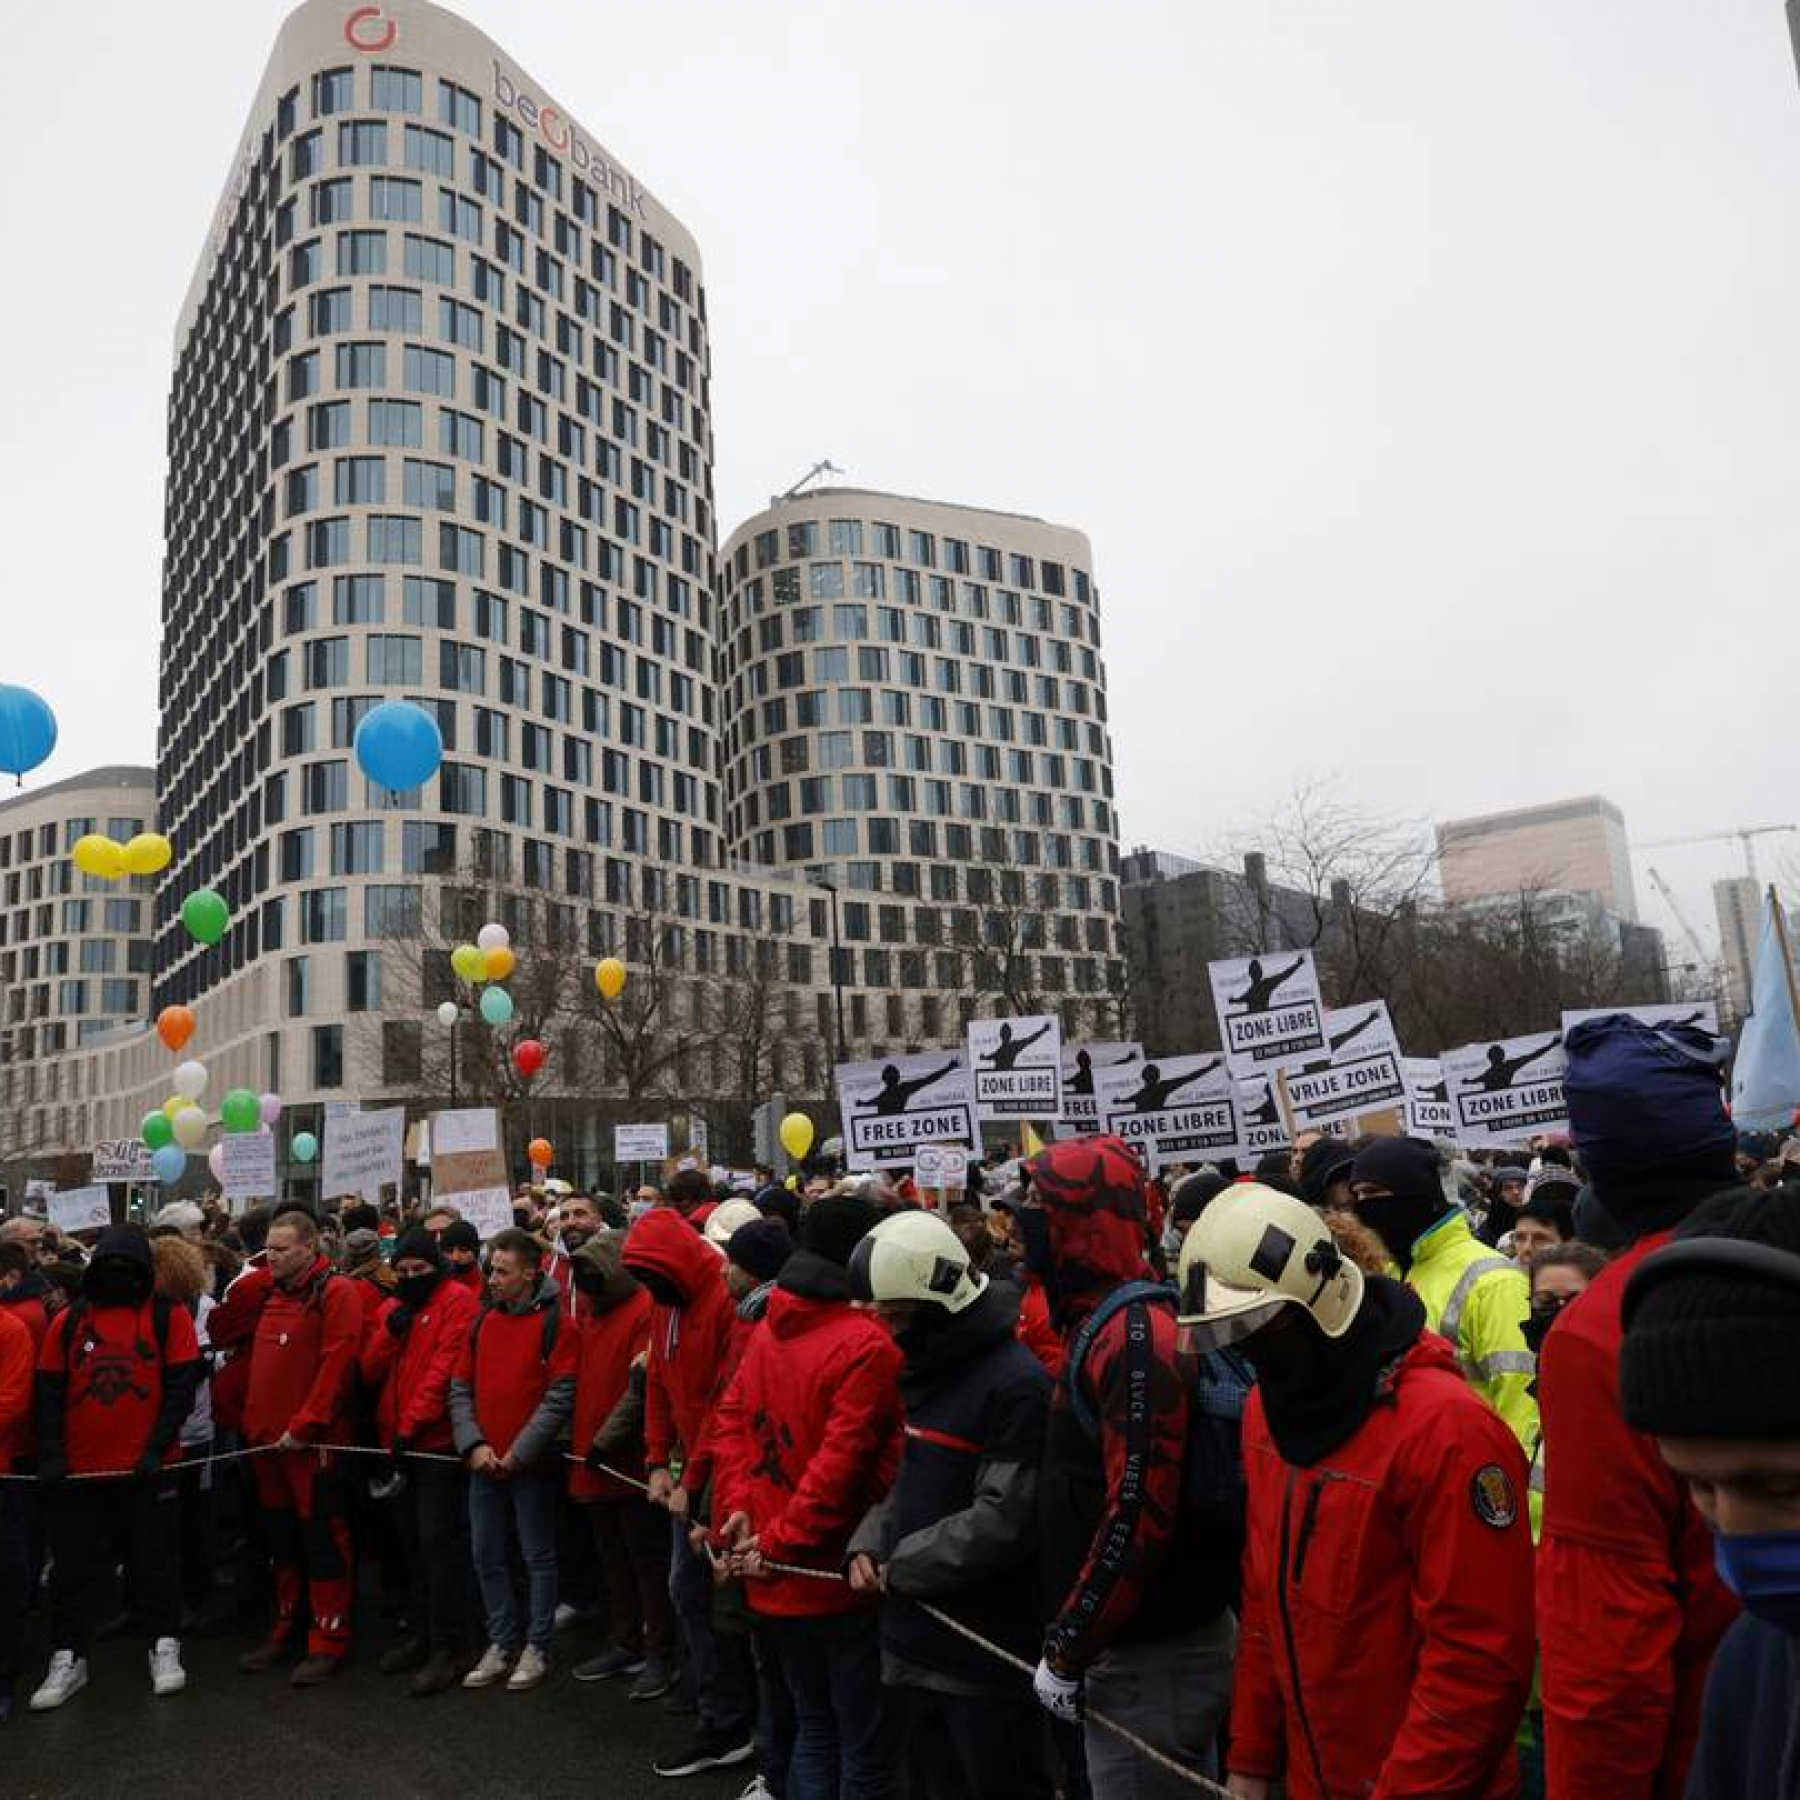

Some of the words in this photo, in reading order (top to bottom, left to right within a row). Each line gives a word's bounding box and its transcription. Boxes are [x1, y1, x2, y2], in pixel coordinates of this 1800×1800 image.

[1235, 1017, 1274, 1041] ZONE
[1276, 1010, 1314, 1034] LIBRE
[981, 1077, 1014, 1094] ZONE
[1019, 1075, 1052, 1092] LIBRE
[1289, 1076, 1340, 1102] VRIJE
[1344, 1063, 1391, 1090] ZONE
[1419, 1106, 1451, 1121] ZON
[1468, 1094, 1515, 1116] ZONE
[863, 1121, 906, 1141] FREE
[911, 1114, 961, 1136] ZONE
[1117, 1117, 1168, 1138] ZONE
[1172, 1110, 1225, 1132] LIBRE
